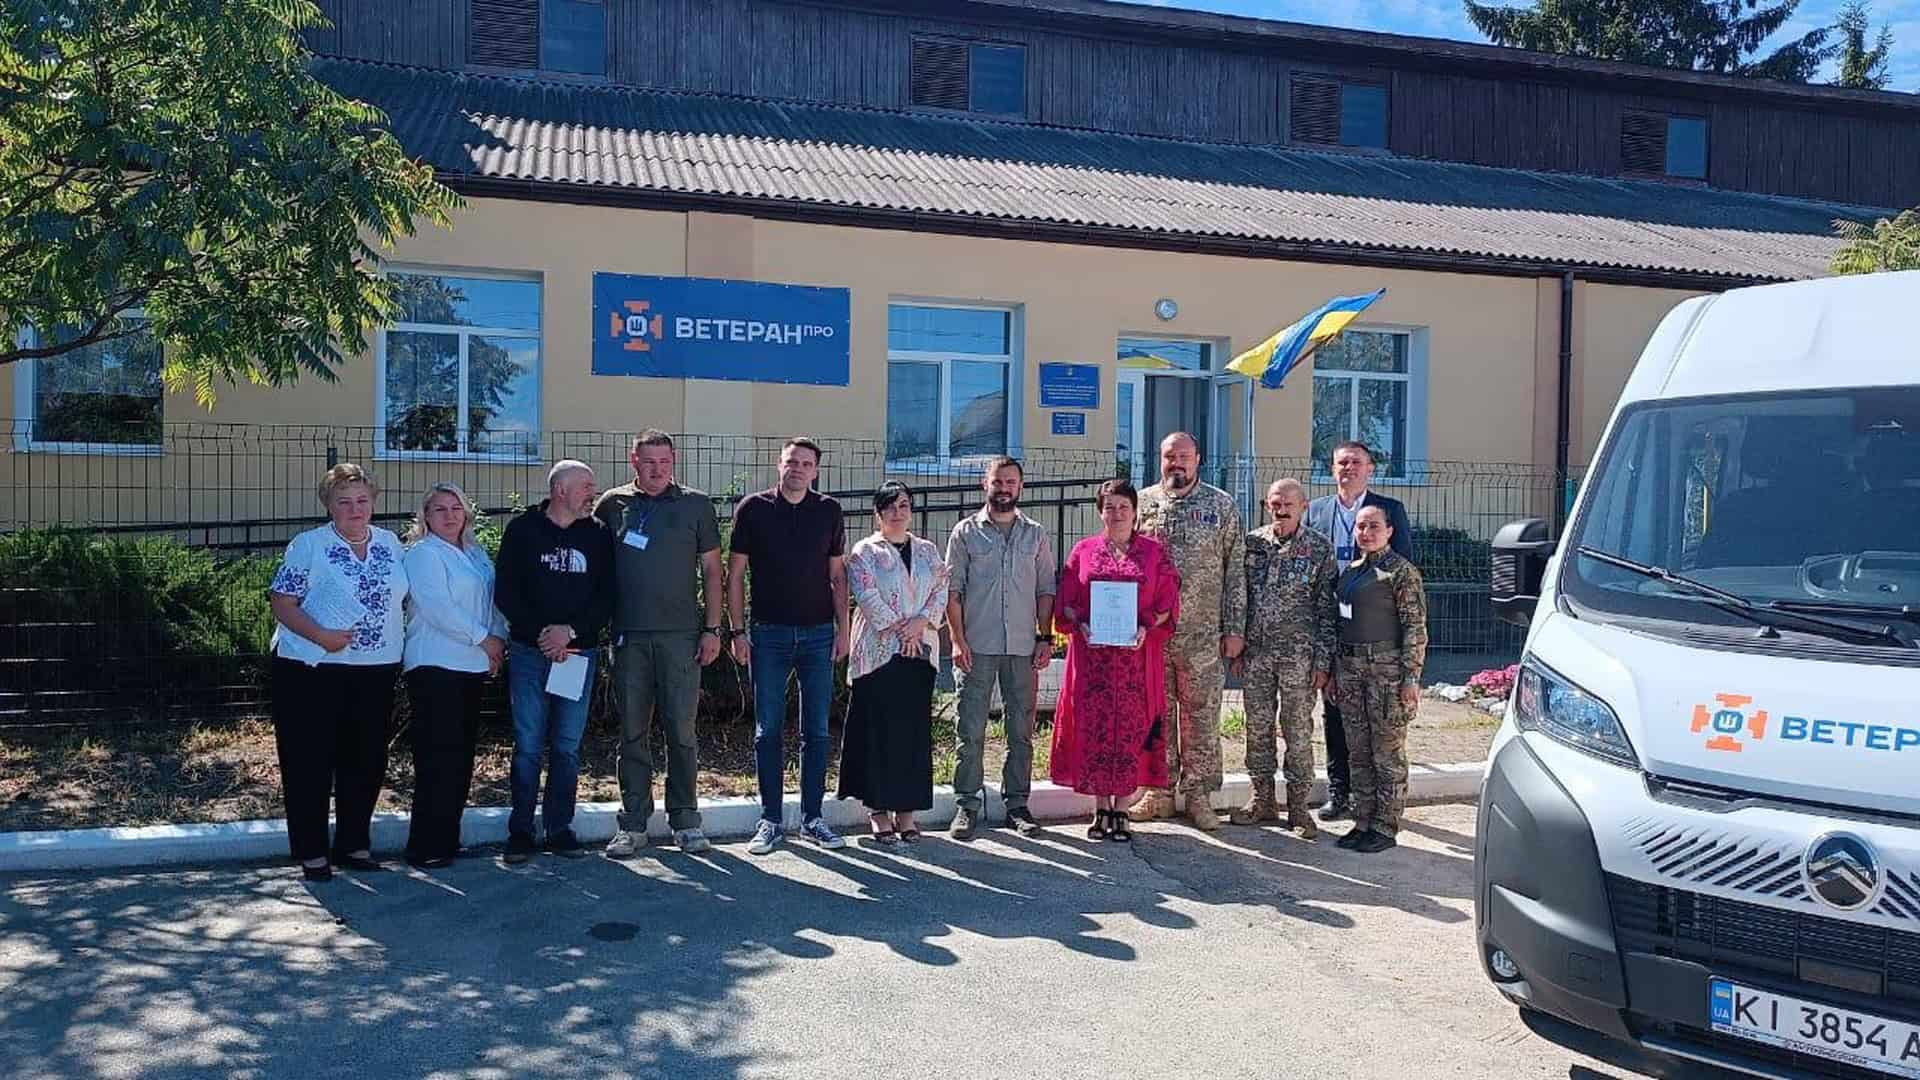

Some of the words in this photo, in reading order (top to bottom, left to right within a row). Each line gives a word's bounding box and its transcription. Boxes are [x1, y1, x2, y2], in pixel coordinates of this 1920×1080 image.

[675, 316, 802, 345] ВЕТЕРАН
[1780, 716, 1920, 751] ВЕТЕР
[1799, 1006, 1886, 1057] 3854
